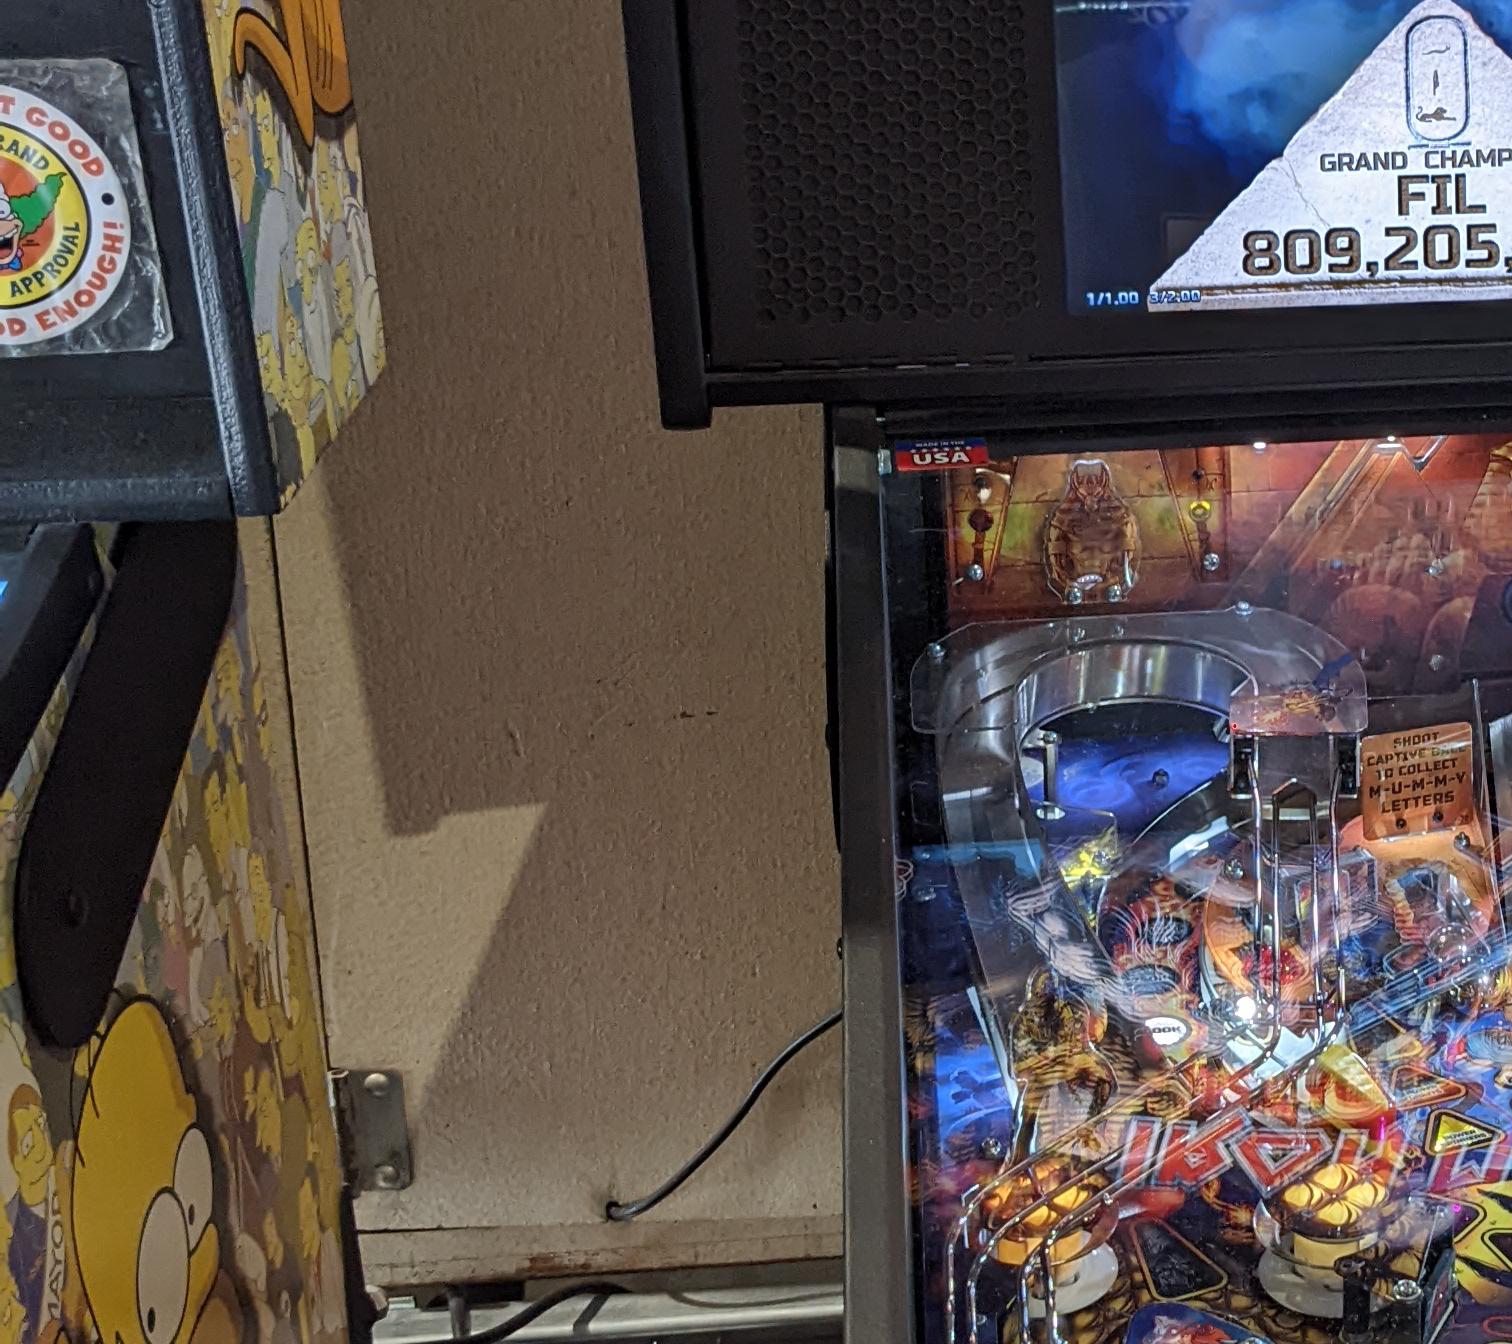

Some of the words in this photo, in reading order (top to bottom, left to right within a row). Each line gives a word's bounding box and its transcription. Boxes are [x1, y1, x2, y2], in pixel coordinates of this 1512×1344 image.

[25, 106, 104, 177] GOOD
[1319, 152, 1408, 173] GRAND
[1397, 173, 1488, 217] FIL
[10, 222, 80, 298] APPROVAL
[35, 222, 125, 332] ENOUGH!
[1086, 291, 1139, 307] 1/1.00
[1149, 290, 1200, 305] 3/2.00
[912, 452, 970, 465] USA
[1393, 731, 1440, 749] SHOOT
[1366, 748, 1427, 767] CAPTIVE
[1398, 758, 1459, 777] COLLECT
[1369, 771, 1467, 798] M-U-M-M-Y
[1381, 791, 1455, 814] LETTERS
